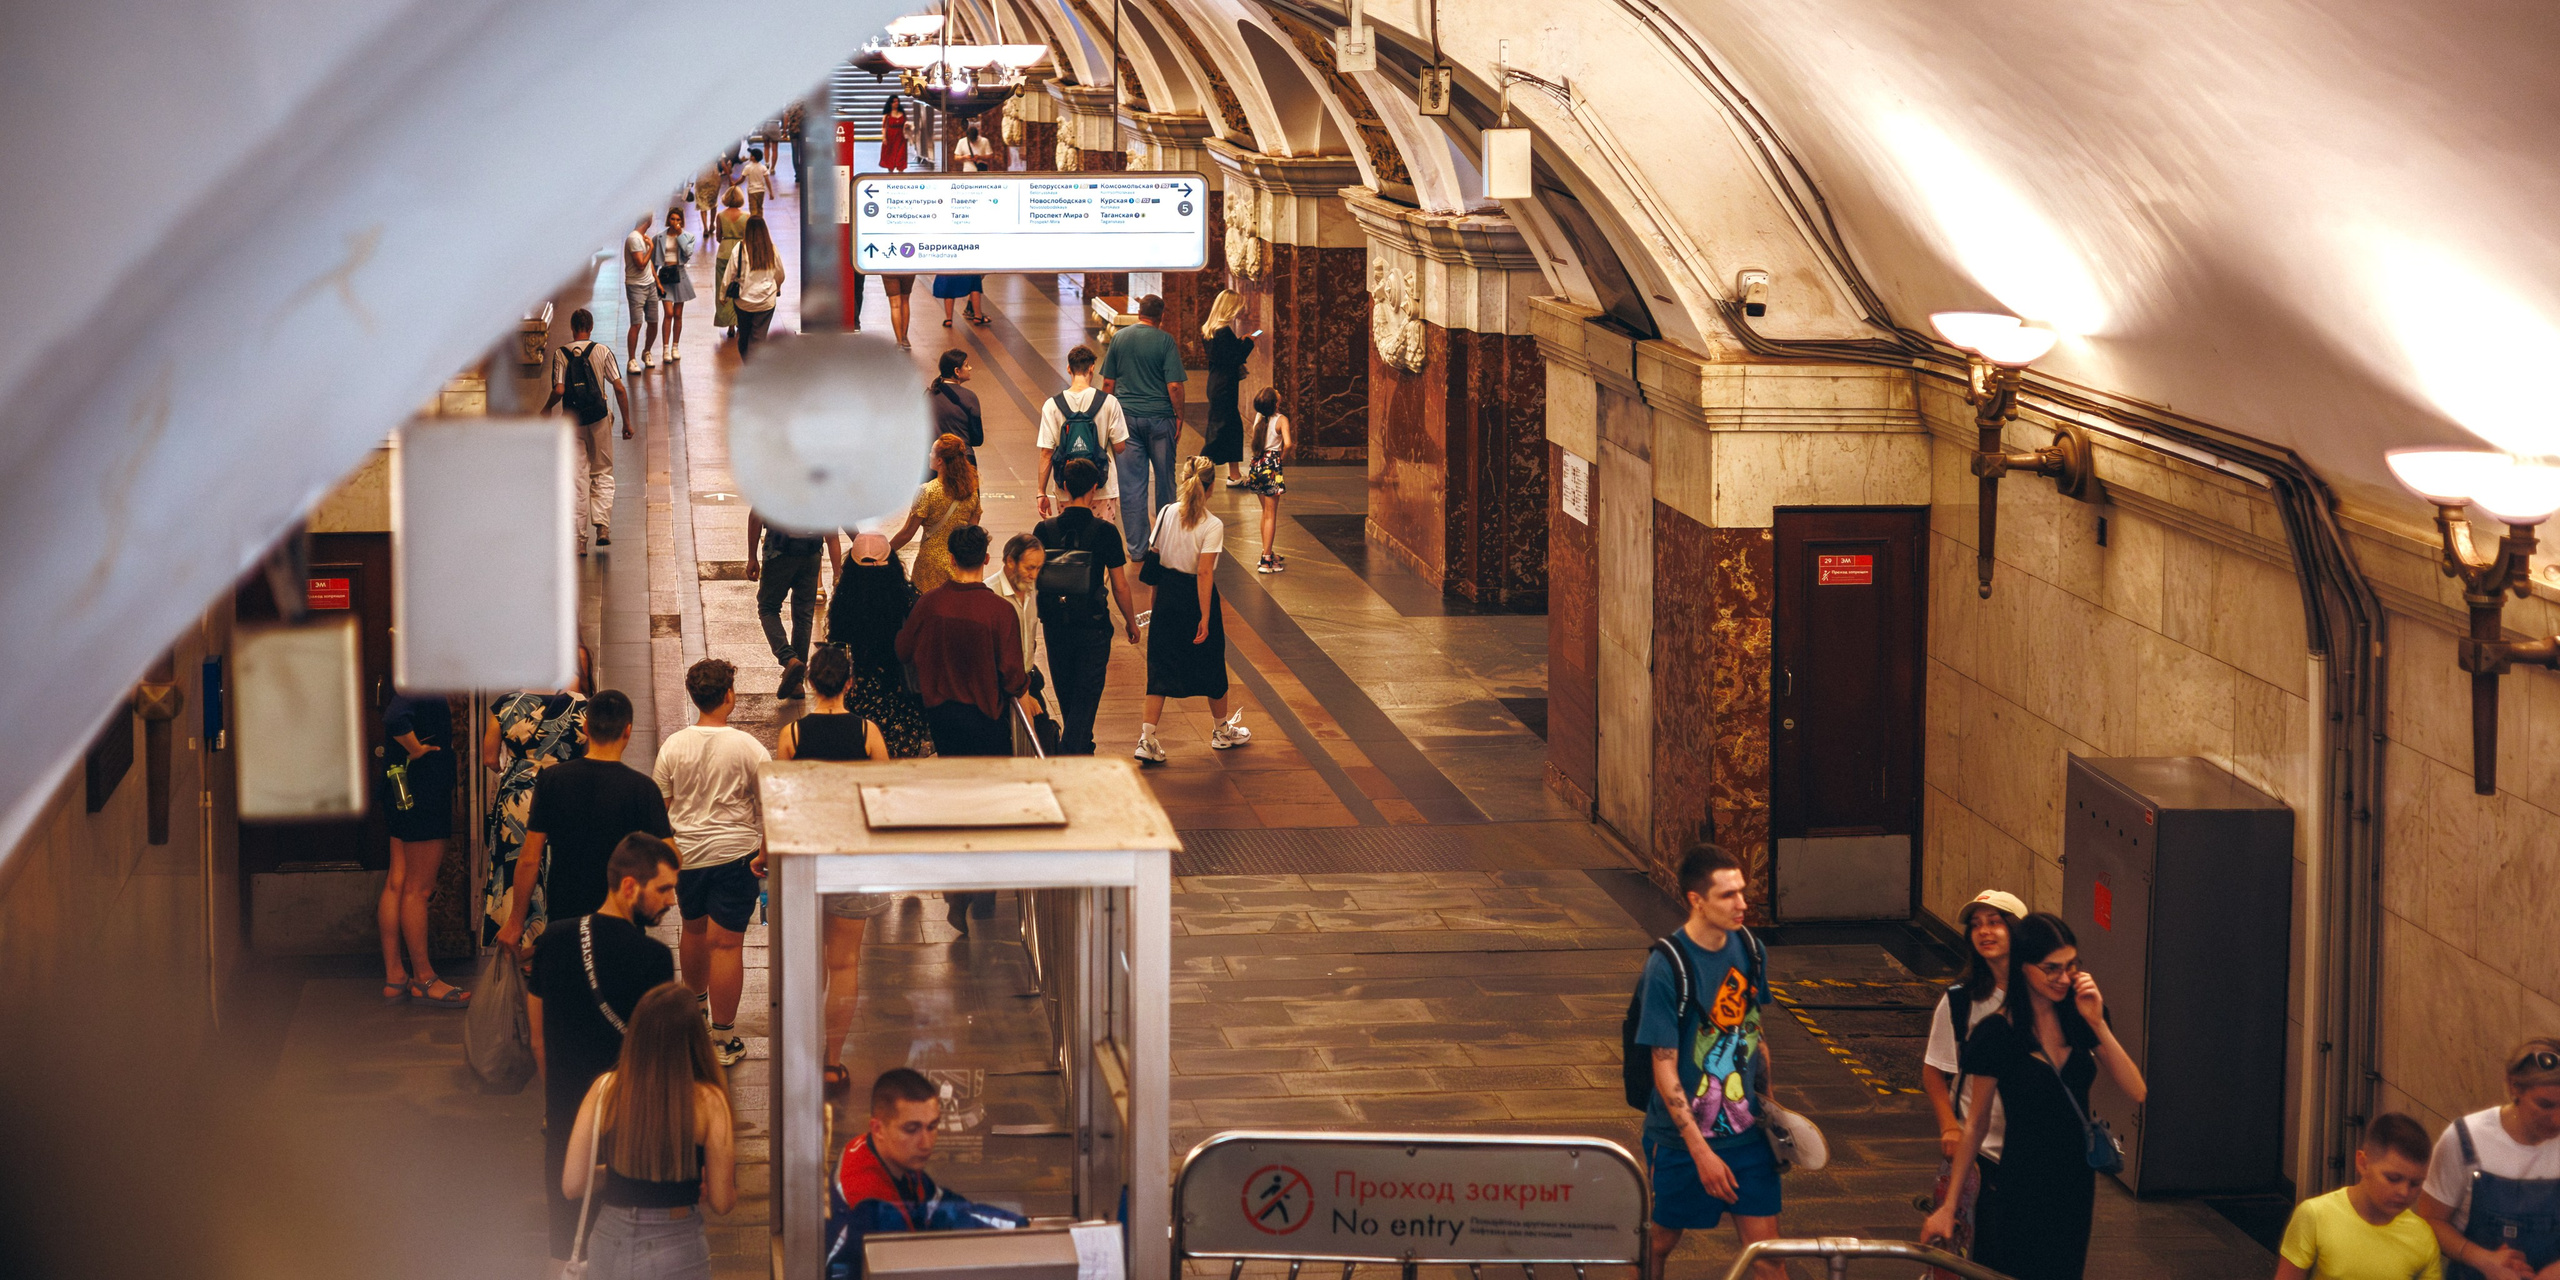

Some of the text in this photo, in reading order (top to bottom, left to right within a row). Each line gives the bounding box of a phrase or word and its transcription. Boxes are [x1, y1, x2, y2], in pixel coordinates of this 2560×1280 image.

[1029, 183, 1073, 191] Белорусская
[1100, 198, 1128, 206] Курская
[1029, 212, 1083, 220] Проспект Мира
[918, 242, 980, 251] Баррикадная
[1334, 1170, 1575, 1210] Проход закрыт
[1331, 1208, 1466, 1246] No entry
